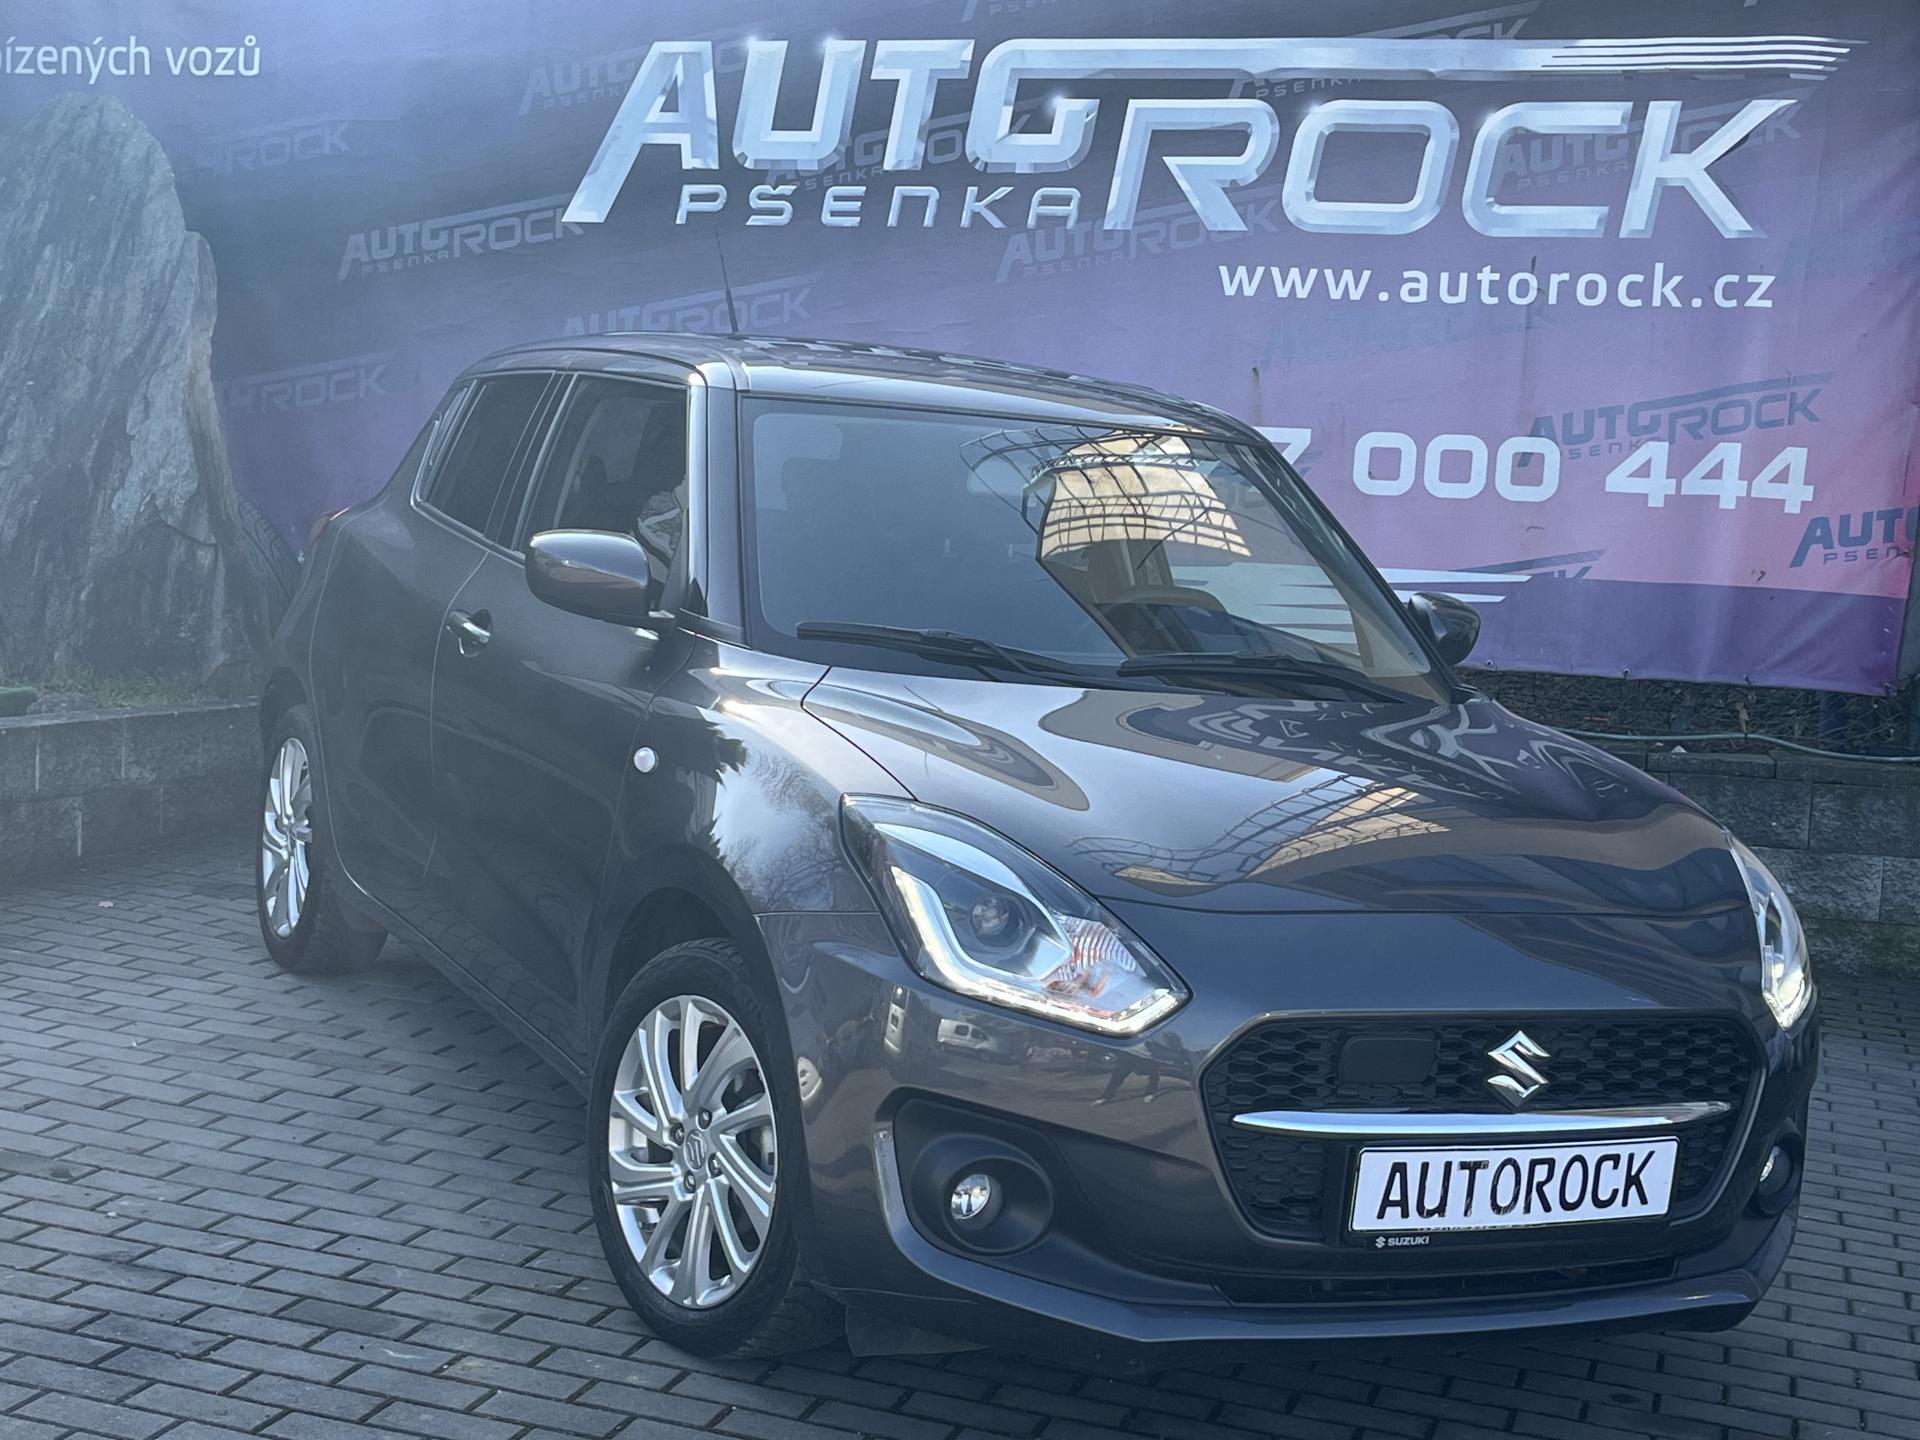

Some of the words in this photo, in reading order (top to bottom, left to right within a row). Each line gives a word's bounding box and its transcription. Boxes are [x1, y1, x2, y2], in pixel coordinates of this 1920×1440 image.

[0, 36, 151, 85] ízených
[165, 34, 262, 77] vozů
[1219, 262, 1776, 309] www.autorock.cz
[1352, 431, 1560, 503] 000
[1604, 440, 1815, 515] 444
[1376, 1150, 1656, 1220] AUTOROCK
[1387, 1235, 1430, 1248] SUZUKI
